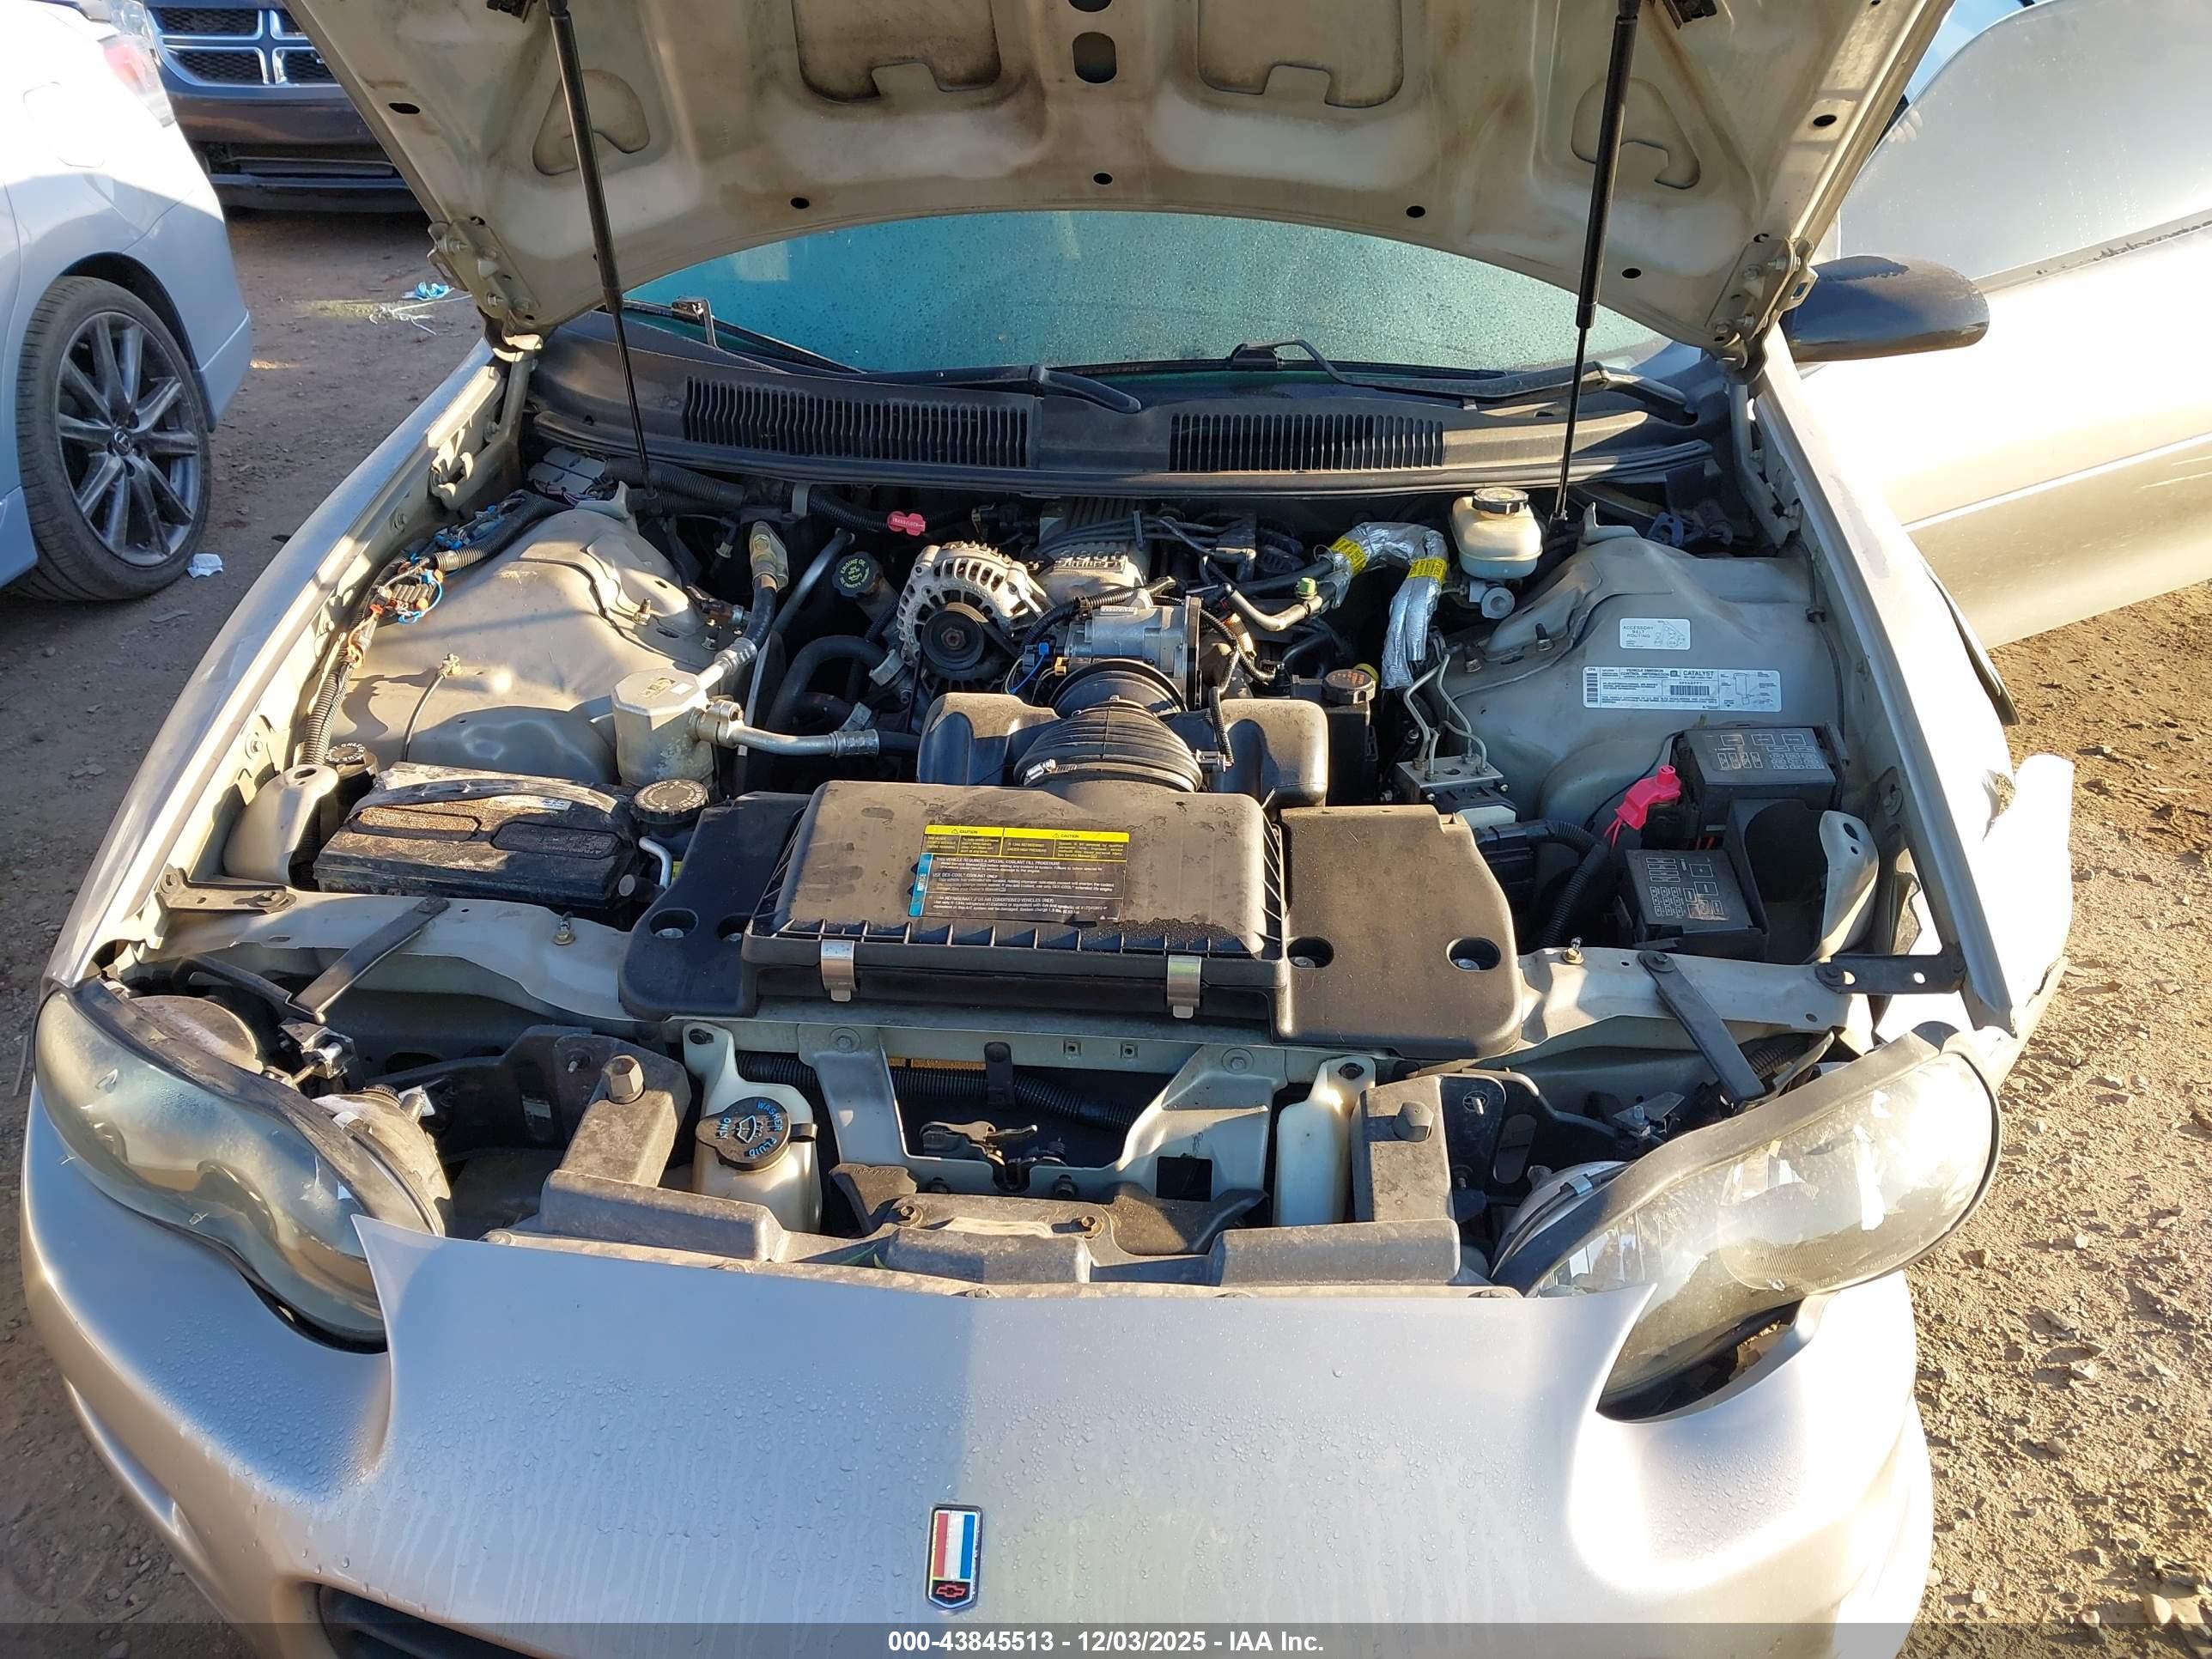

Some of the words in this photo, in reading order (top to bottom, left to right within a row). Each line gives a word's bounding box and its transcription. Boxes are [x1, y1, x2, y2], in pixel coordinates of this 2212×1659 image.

[916, 872, 927, 892] NOTICE
[757, 1099, 783, 1133] WASHER
[716, 1116, 732, 1140] ONLY
[748, 1137, 777, 1159] FLUID
